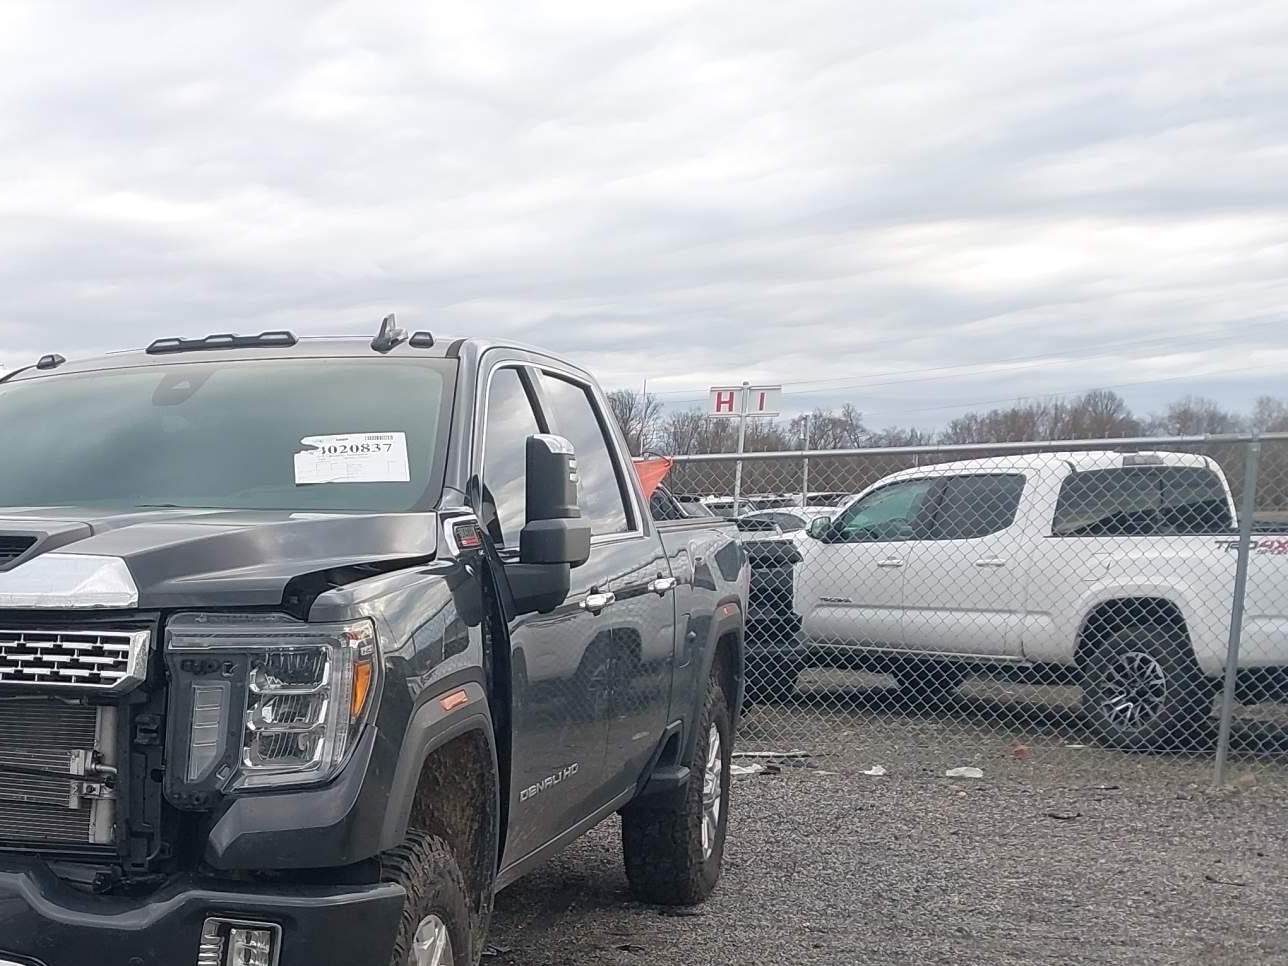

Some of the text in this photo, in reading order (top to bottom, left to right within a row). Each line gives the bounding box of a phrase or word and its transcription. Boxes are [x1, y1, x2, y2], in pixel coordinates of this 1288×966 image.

[715, 391, 734, 412] H
[758, 392, 765, 411] I
[520, 762, 578, 802] DENALI HD
